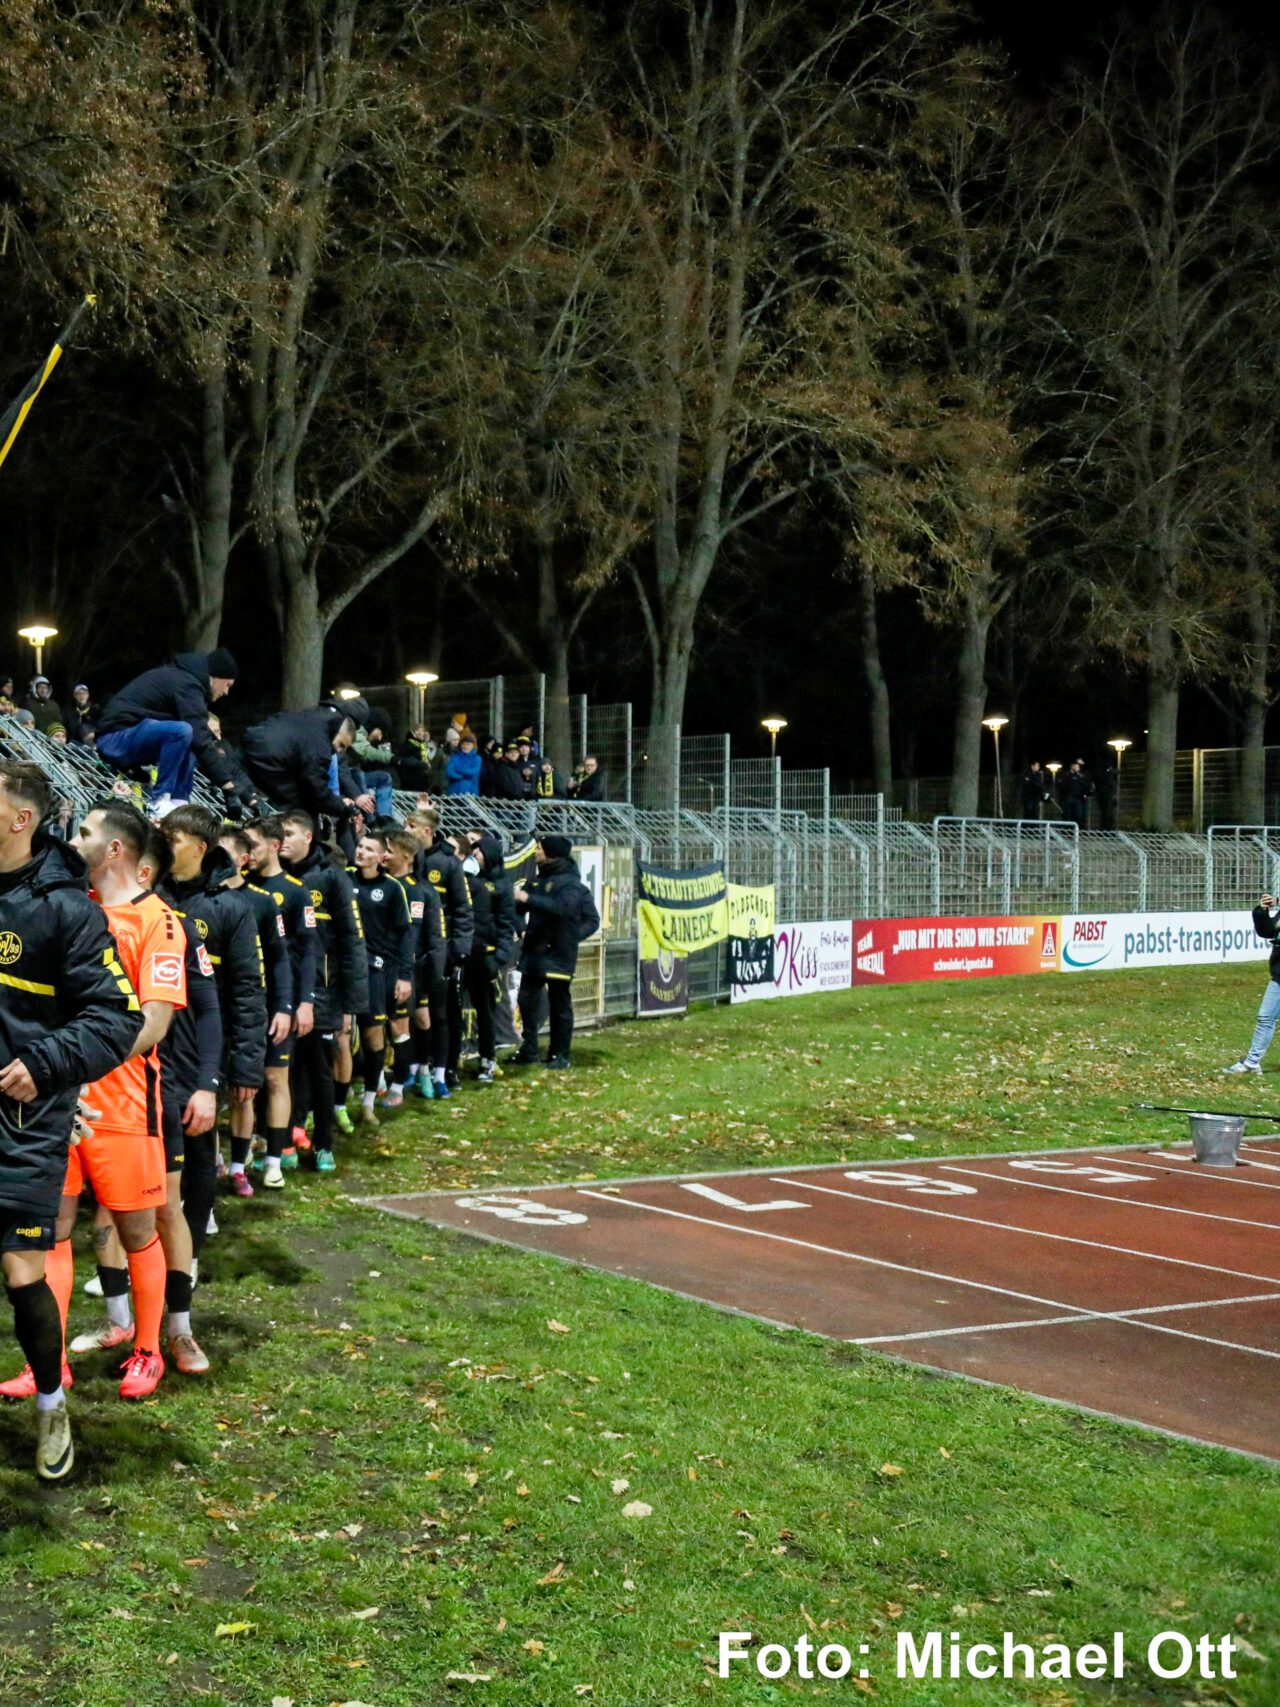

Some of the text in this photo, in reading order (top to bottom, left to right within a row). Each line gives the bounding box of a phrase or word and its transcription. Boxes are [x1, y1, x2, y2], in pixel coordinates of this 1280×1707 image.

[662, 912, 718, 942] LAINECK
[918, 928, 936, 949] MIT
[937, 928, 954, 948] DIR
[955, 928, 976, 947] SIND
[977, 927, 995, 946] WIR
[1073, 920, 1107, 941] PABST
[856, 930, 873, 953] TEAM
[863, 951, 885, 976] METALL
[680, 1182, 811, 1212] 7
[455, 1196, 588, 1225] 8
